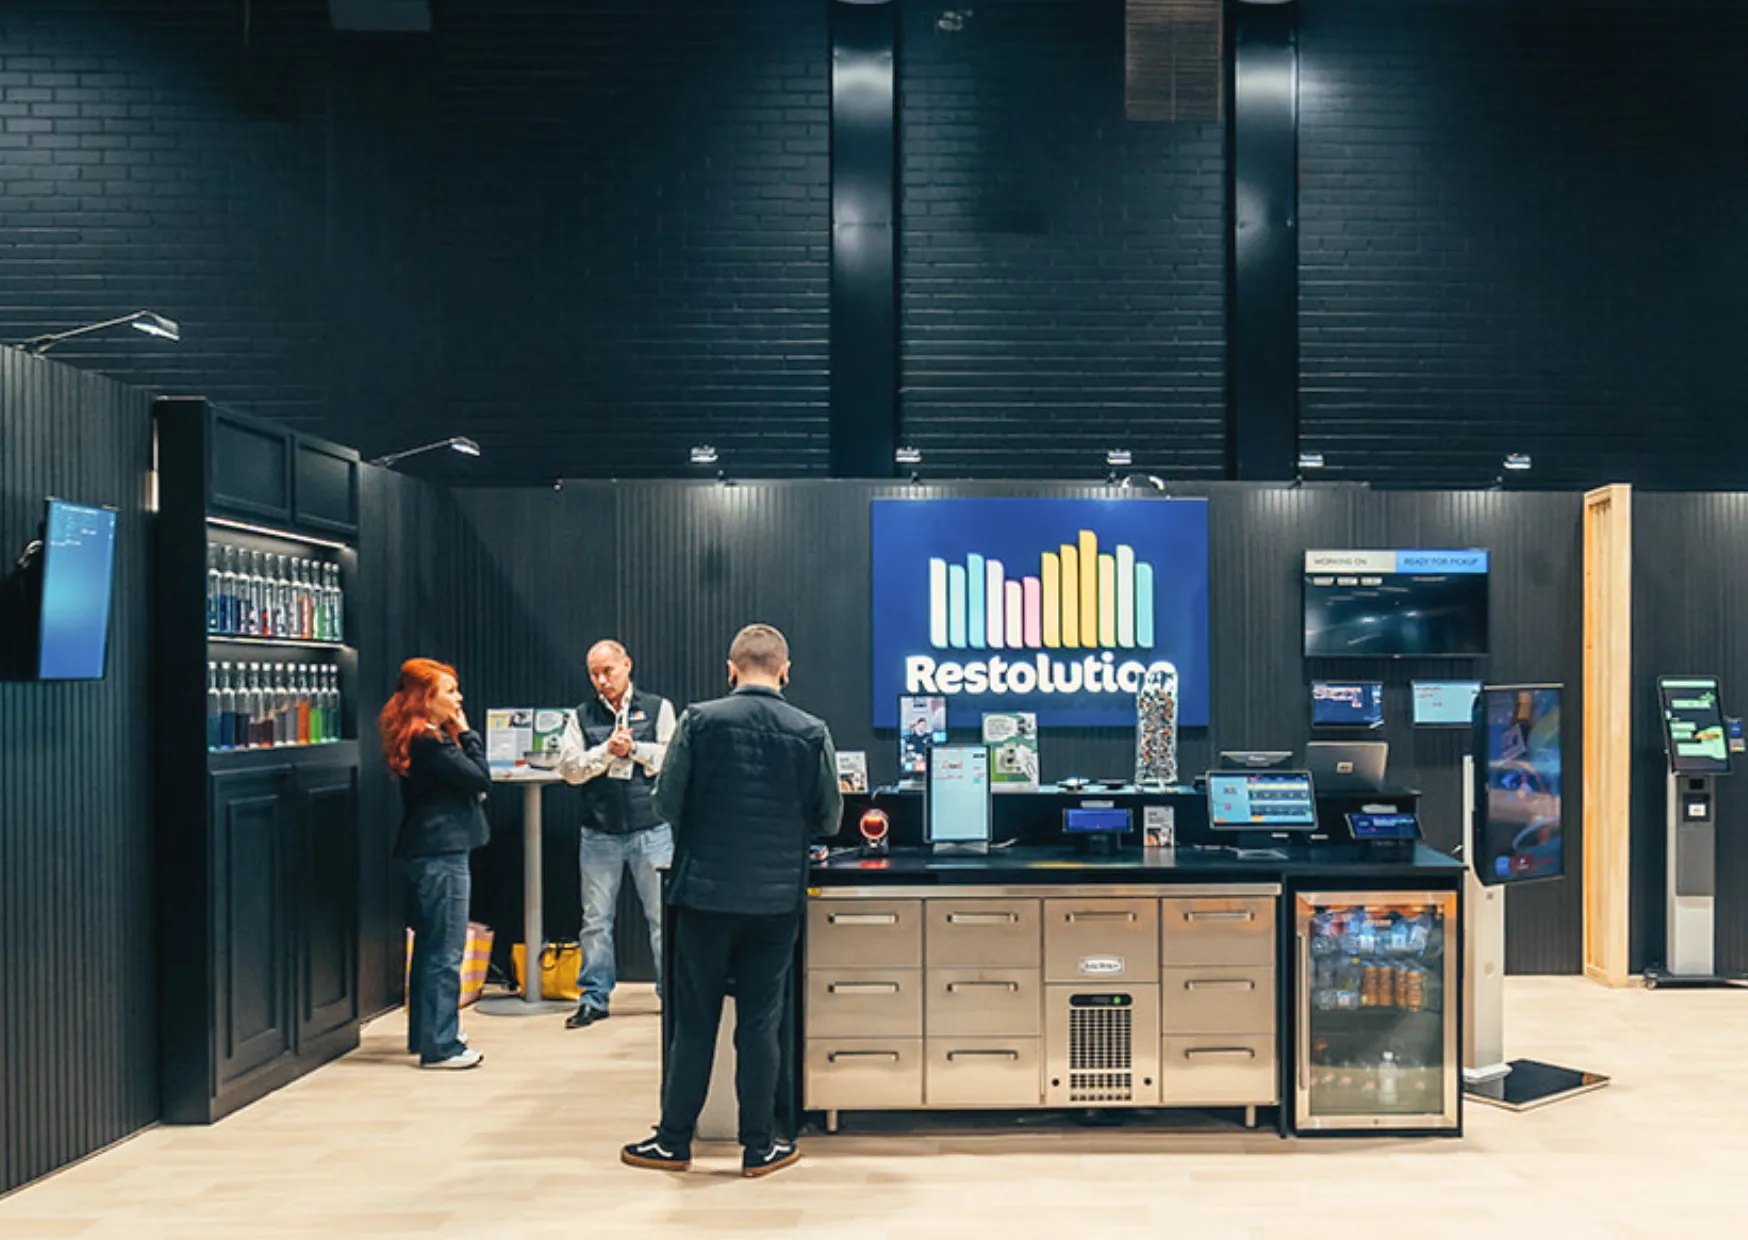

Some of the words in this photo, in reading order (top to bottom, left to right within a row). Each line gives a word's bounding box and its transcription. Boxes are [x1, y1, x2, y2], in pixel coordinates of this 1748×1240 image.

[1313, 557, 1352, 566] WORKING
[1354, 557, 1368, 566] ON
[1403, 557, 1429, 566] READY
[1431, 557, 1448, 566] FOR
[1450, 557, 1478, 566] PICKUP
